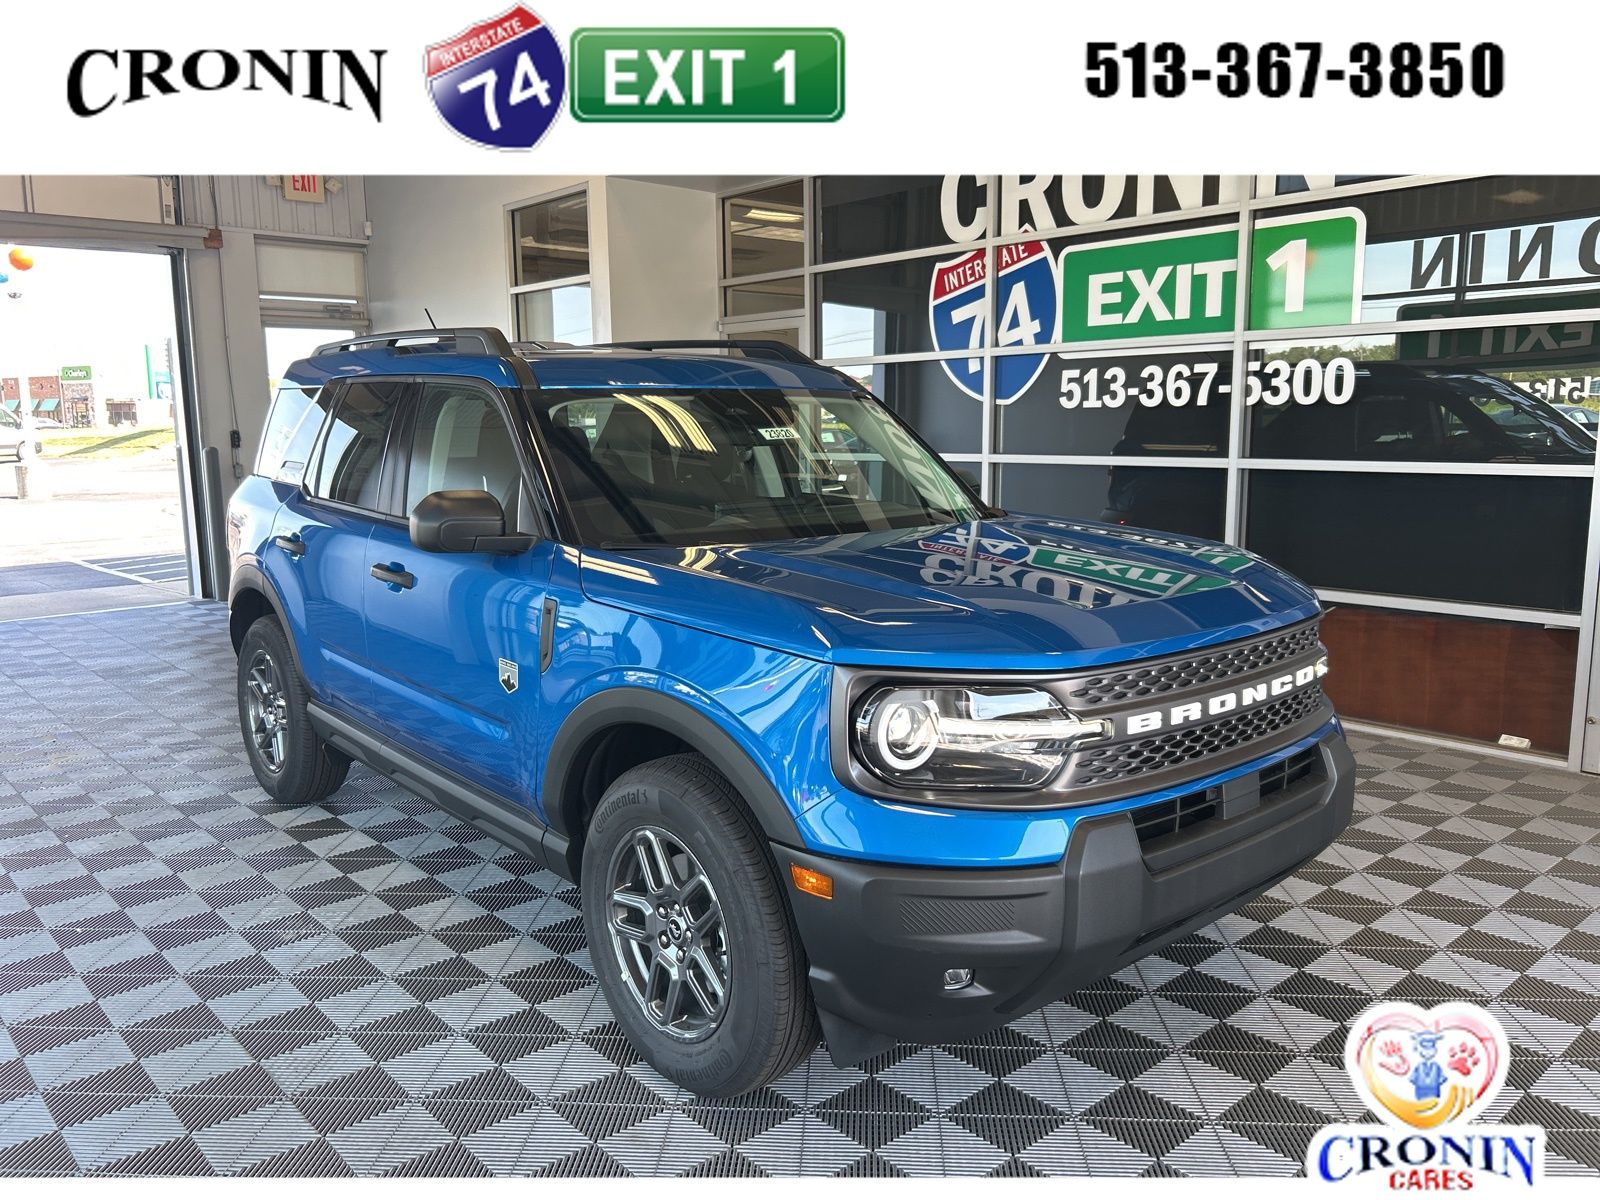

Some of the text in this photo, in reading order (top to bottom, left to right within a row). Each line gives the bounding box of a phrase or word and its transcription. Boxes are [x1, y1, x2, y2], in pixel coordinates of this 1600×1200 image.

[292, 174, 317, 193] EXIT
[940, 175, 1334, 243] CRO
[943, 244, 1028, 293] INTERATE
[1087, 238, 1307, 327] EXIT 1
[951, 281, 1041, 374] 74
[1059, 357, 1355, 409] 513-367-5300
[1127, 665, 1315, 735] BRONCO
[594, 789, 640, 833] Continental
